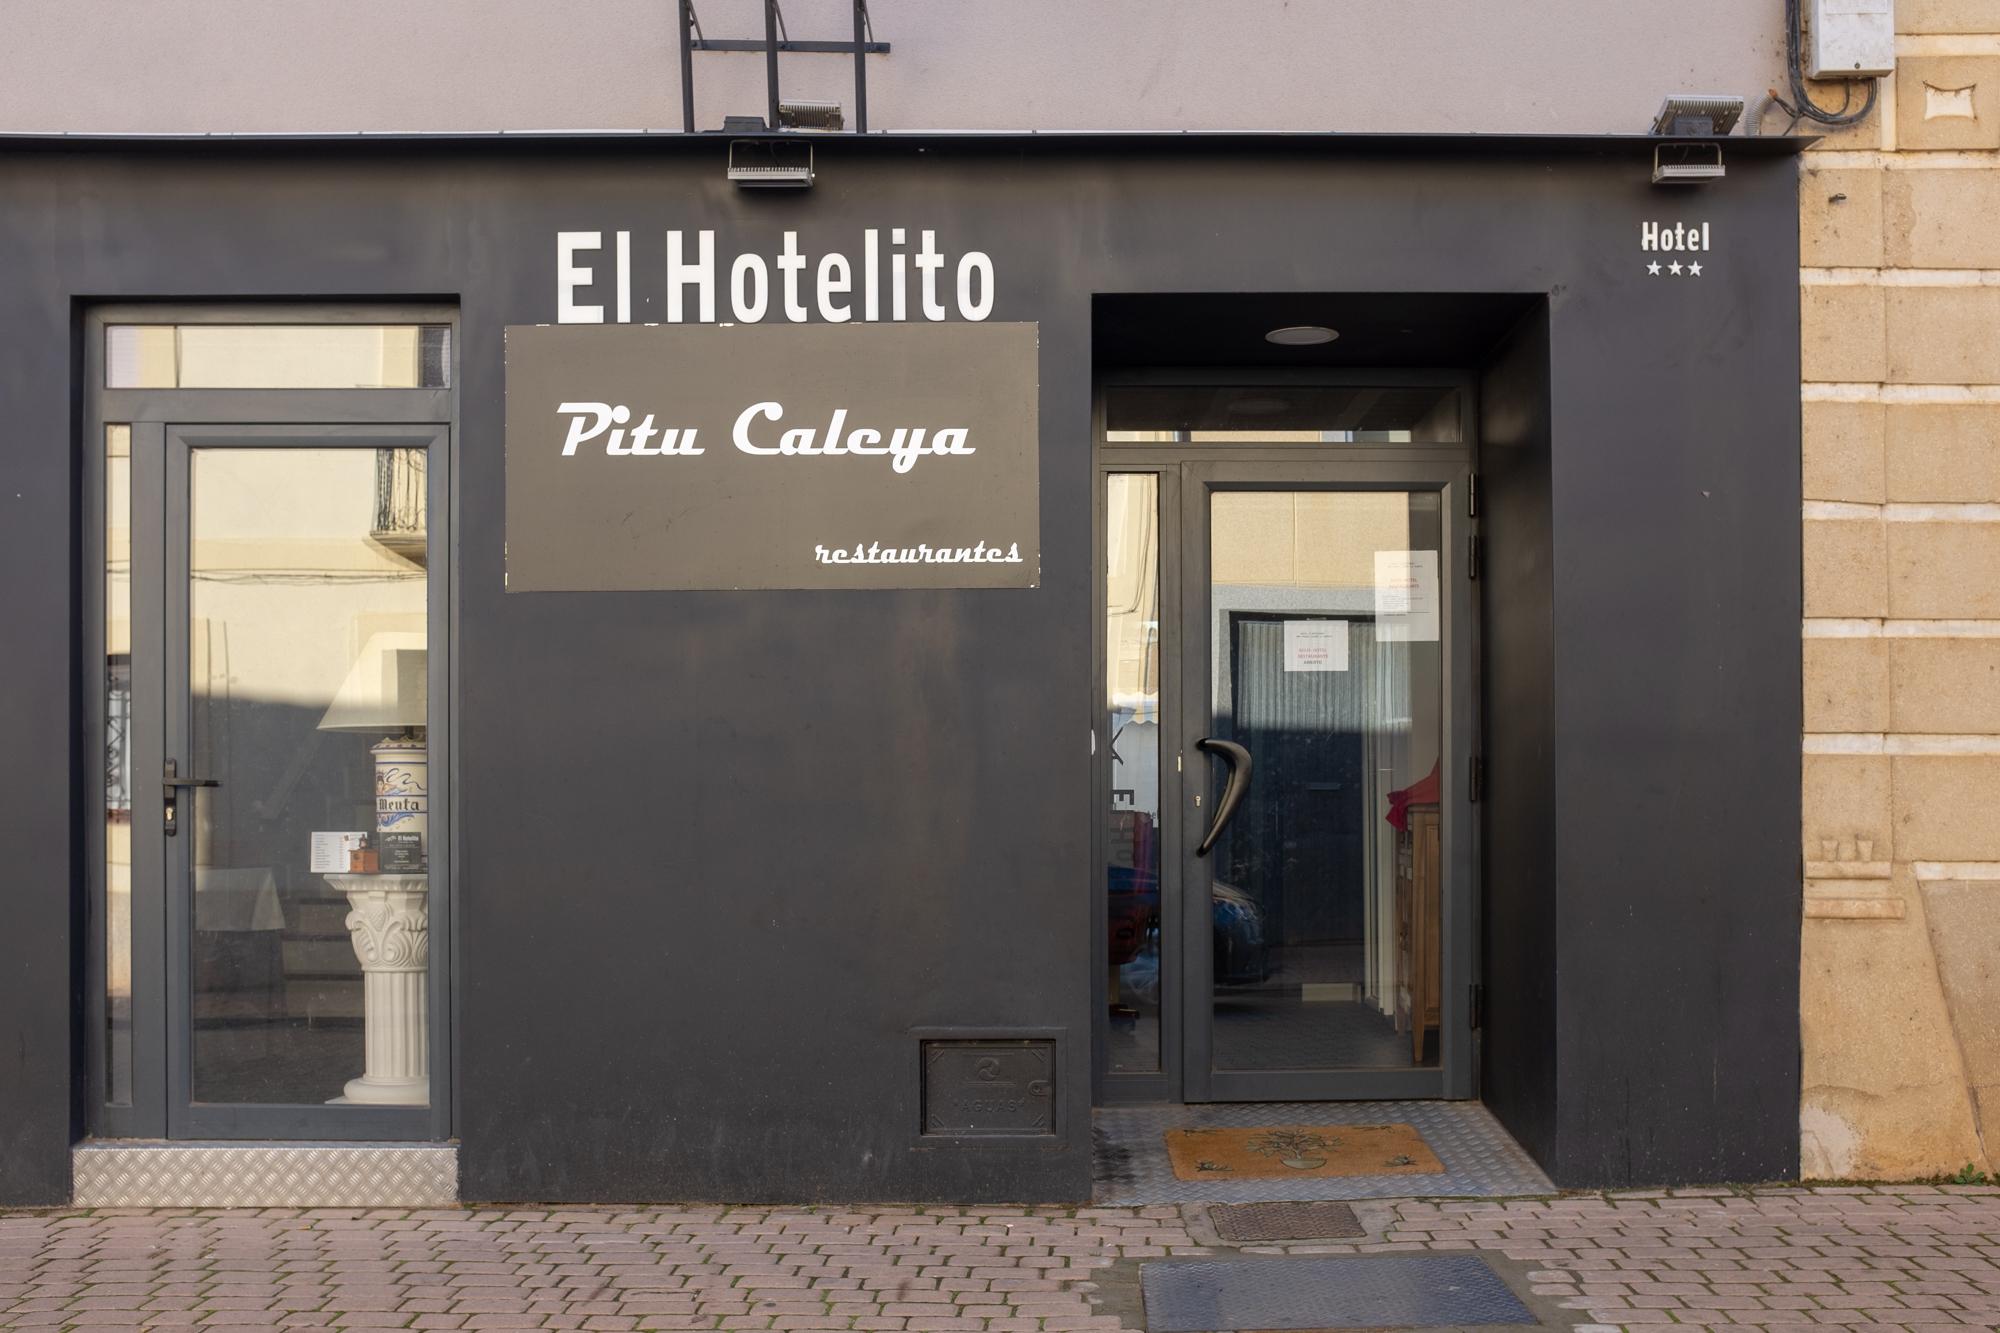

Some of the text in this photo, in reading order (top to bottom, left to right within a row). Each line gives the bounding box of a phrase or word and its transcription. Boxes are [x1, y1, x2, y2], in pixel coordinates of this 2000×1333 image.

[1641, 221, 1710, 251] Hotel
[557, 227, 995, 324] El Hotelito
[556, 401, 977, 474] Pitu Caleya
[814, 540, 1023, 564] restaurantes
[378, 798, 420, 811] Menta
